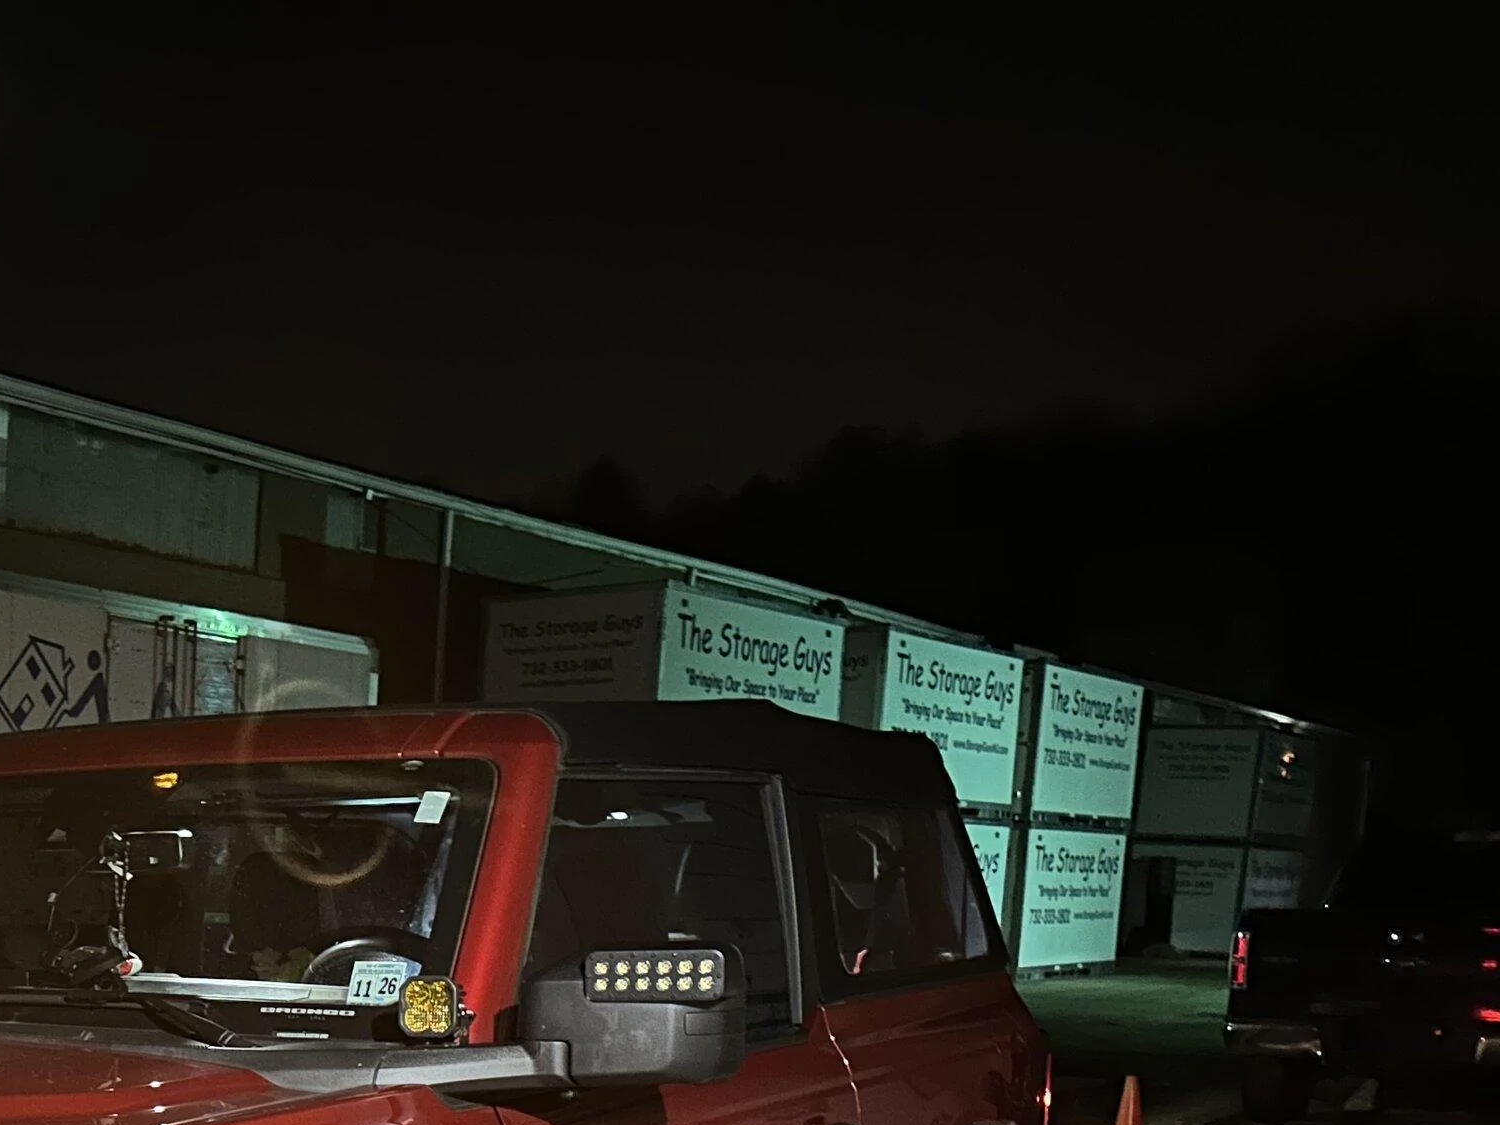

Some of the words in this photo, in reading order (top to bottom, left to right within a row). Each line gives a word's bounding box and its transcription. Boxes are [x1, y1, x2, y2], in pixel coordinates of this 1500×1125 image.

[678, 613, 712, 654] The
[719, 623, 789, 676] Storage
[794, 636, 832, 684] Guys
[897, 652, 924, 688] The
[928, 660, 982, 706] Storage
[984, 669, 1014, 711] Guys
[1050, 683, 1070, 713] The
[1072, 689, 1112, 729] Storage
[1114, 696, 1136, 732] Guys
[1036, 845, 1055, 872] The
[1057, 847, 1095, 881] Storage
[1097, 848, 1120, 882] Guys
[353, 980, 371, 997] 11
[378, 977, 397, 994] 26
[260, 1007, 355, 1016] BRONCO
